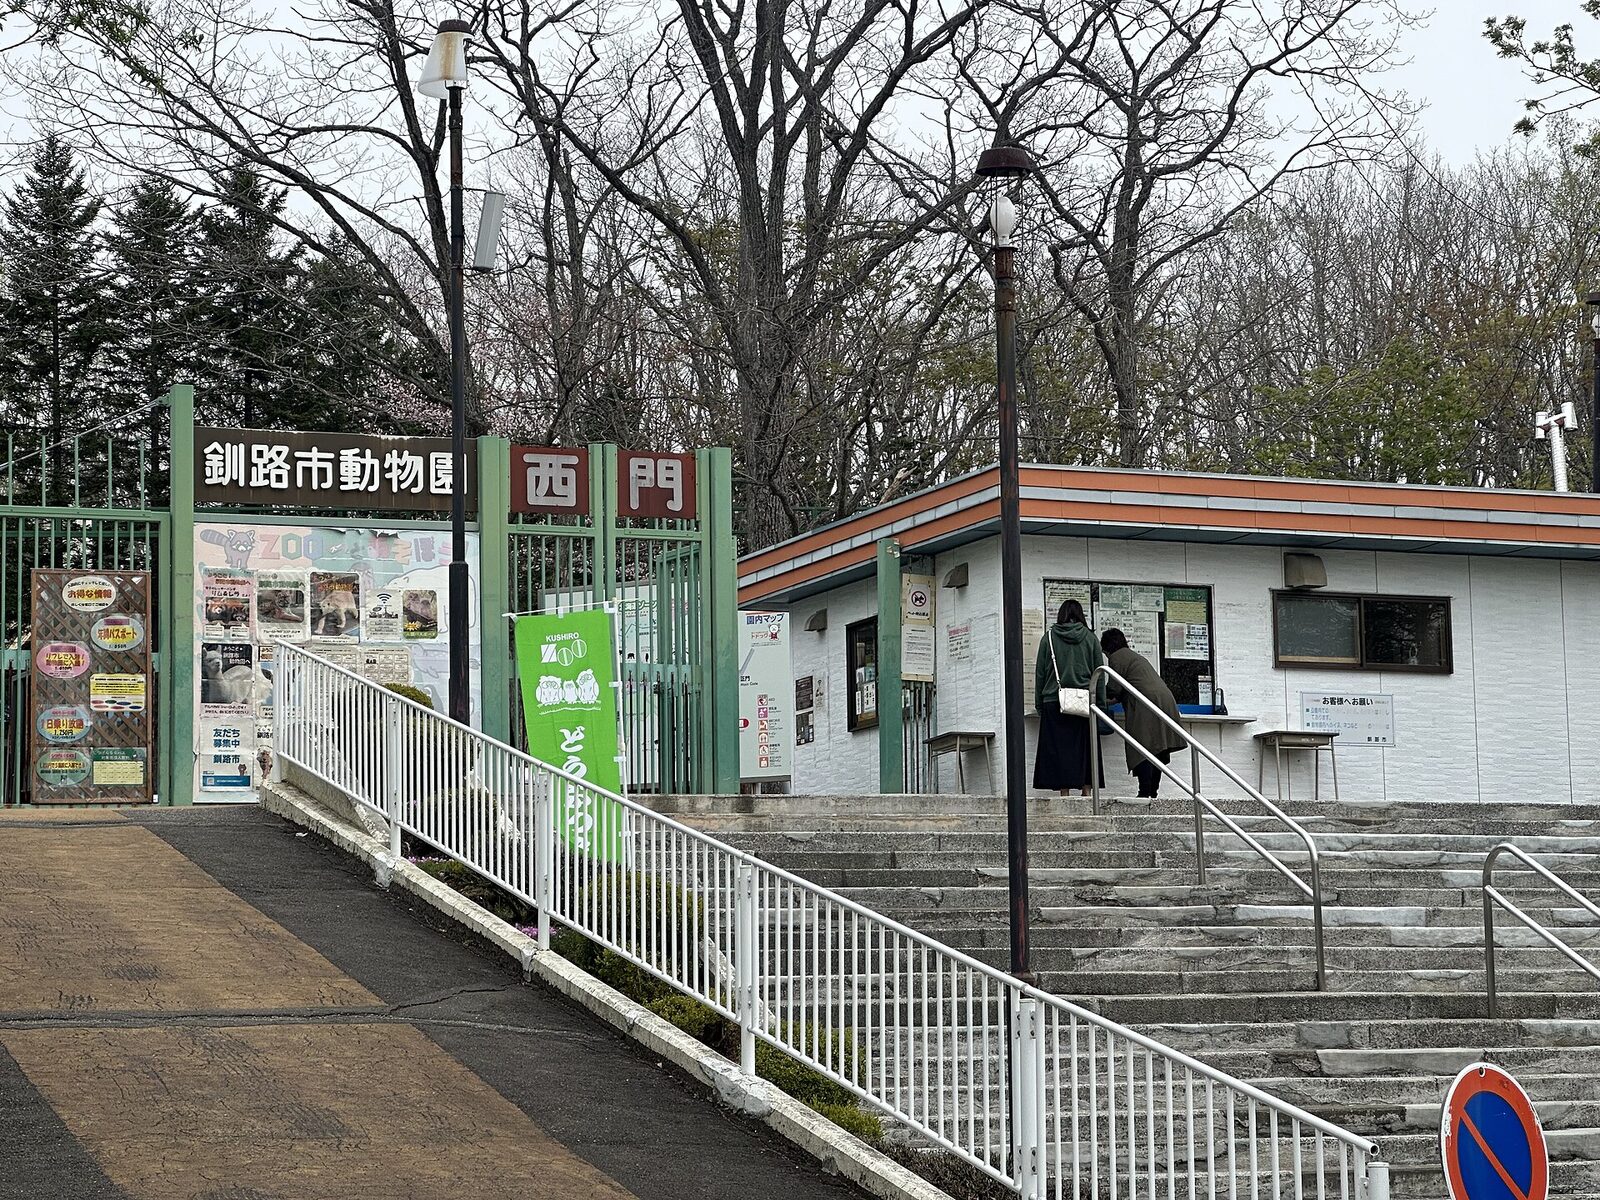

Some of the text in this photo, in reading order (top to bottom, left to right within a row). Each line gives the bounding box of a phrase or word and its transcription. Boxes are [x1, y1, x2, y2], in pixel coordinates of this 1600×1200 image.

[203, 441, 468, 496] 釧路市動物園
[523, 453, 579, 508] 西
[630, 457, 683, 512] 門
[67, 589, 112, 599] お得な情報
[746, 612, 785, 625] 園内マップ
[545, 632, 580, 642] KUSHIRO
[1322, 696, 1374, 706] お客様へお願い
[213, 728, 241, 738] 友だち
[213, 739, 240, 749] 募集中
[213, 755, 241, 764] 釧路市
